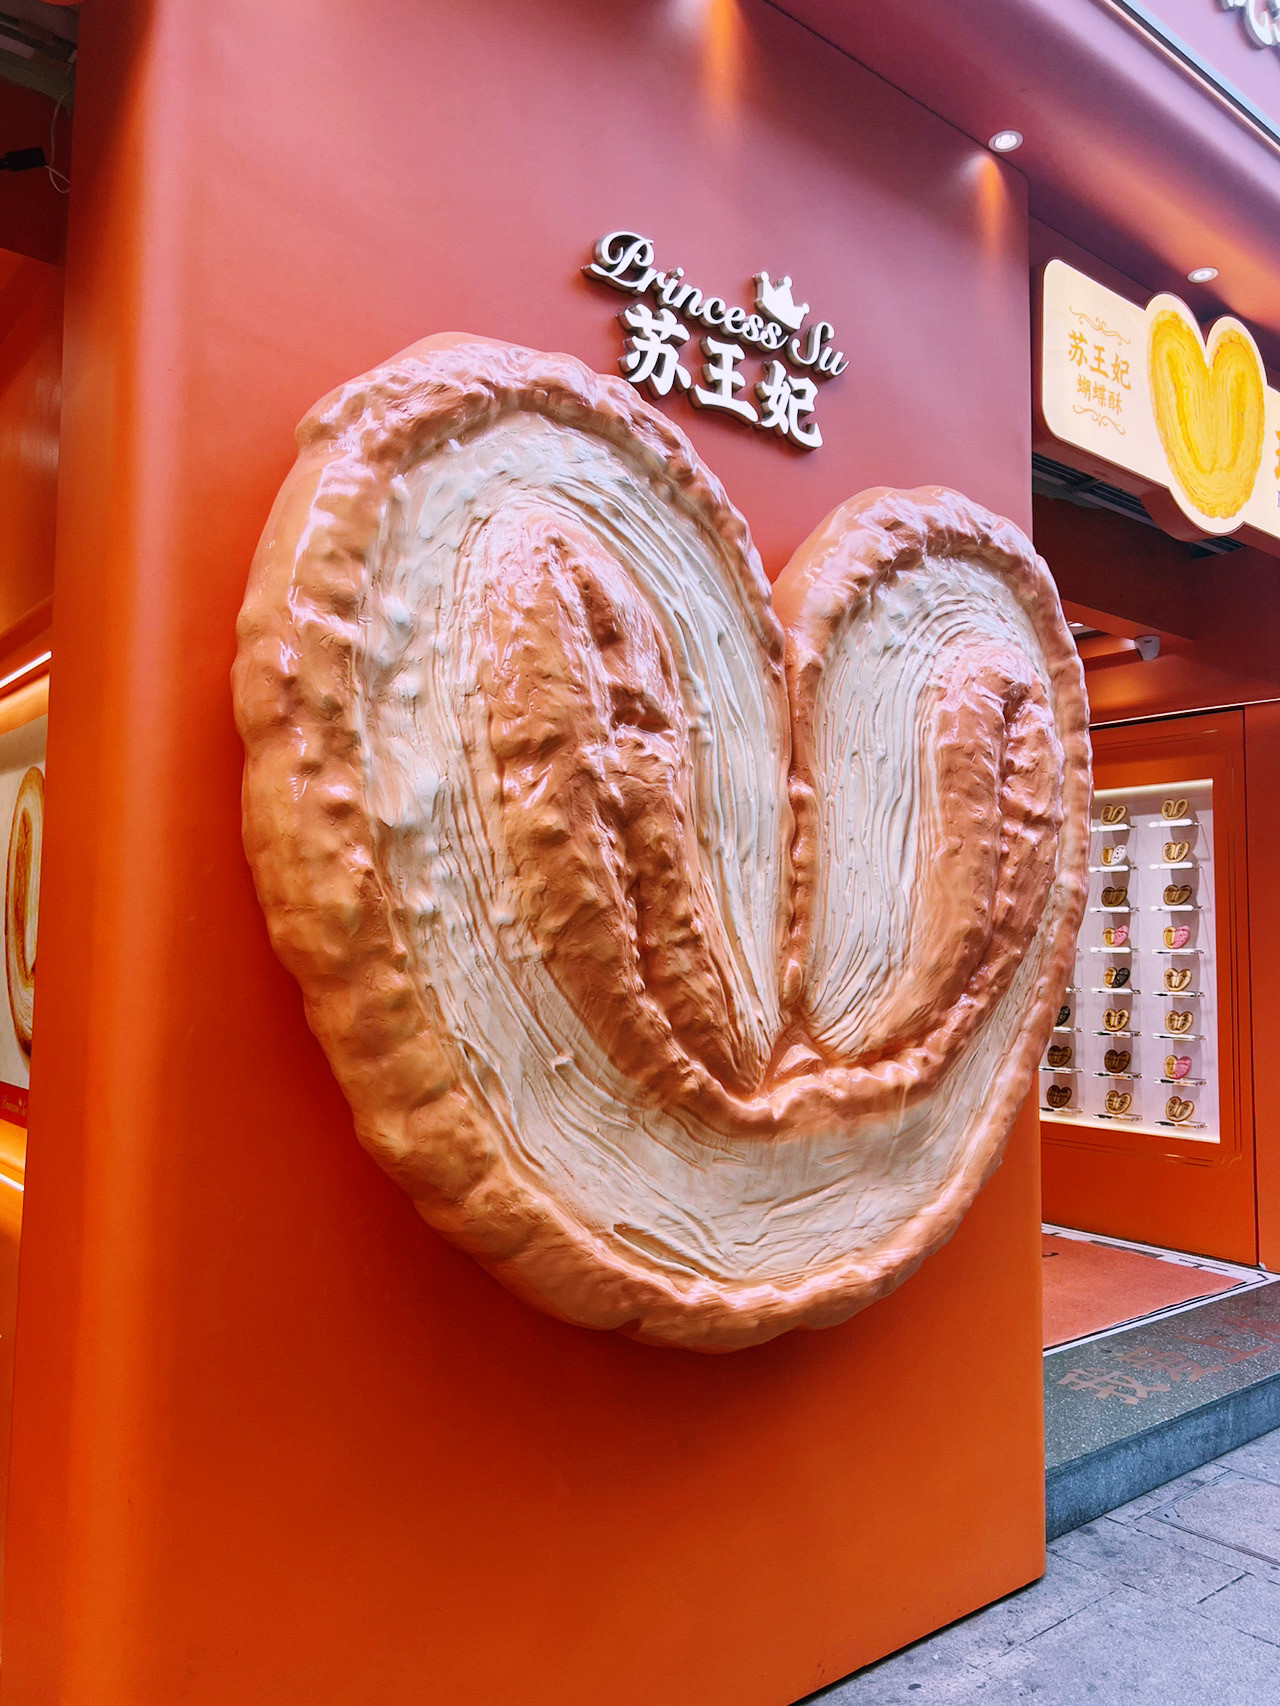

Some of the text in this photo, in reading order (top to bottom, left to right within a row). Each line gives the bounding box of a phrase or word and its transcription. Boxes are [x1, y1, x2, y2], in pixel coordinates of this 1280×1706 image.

[580, 231, 849, 378] Princess Su
[616, 303, 823, 450] 苏王妃
[1068, 330, 1131, 390] 苏王妃
[1077, 373, 1122, 415] 蝴蝶酥
